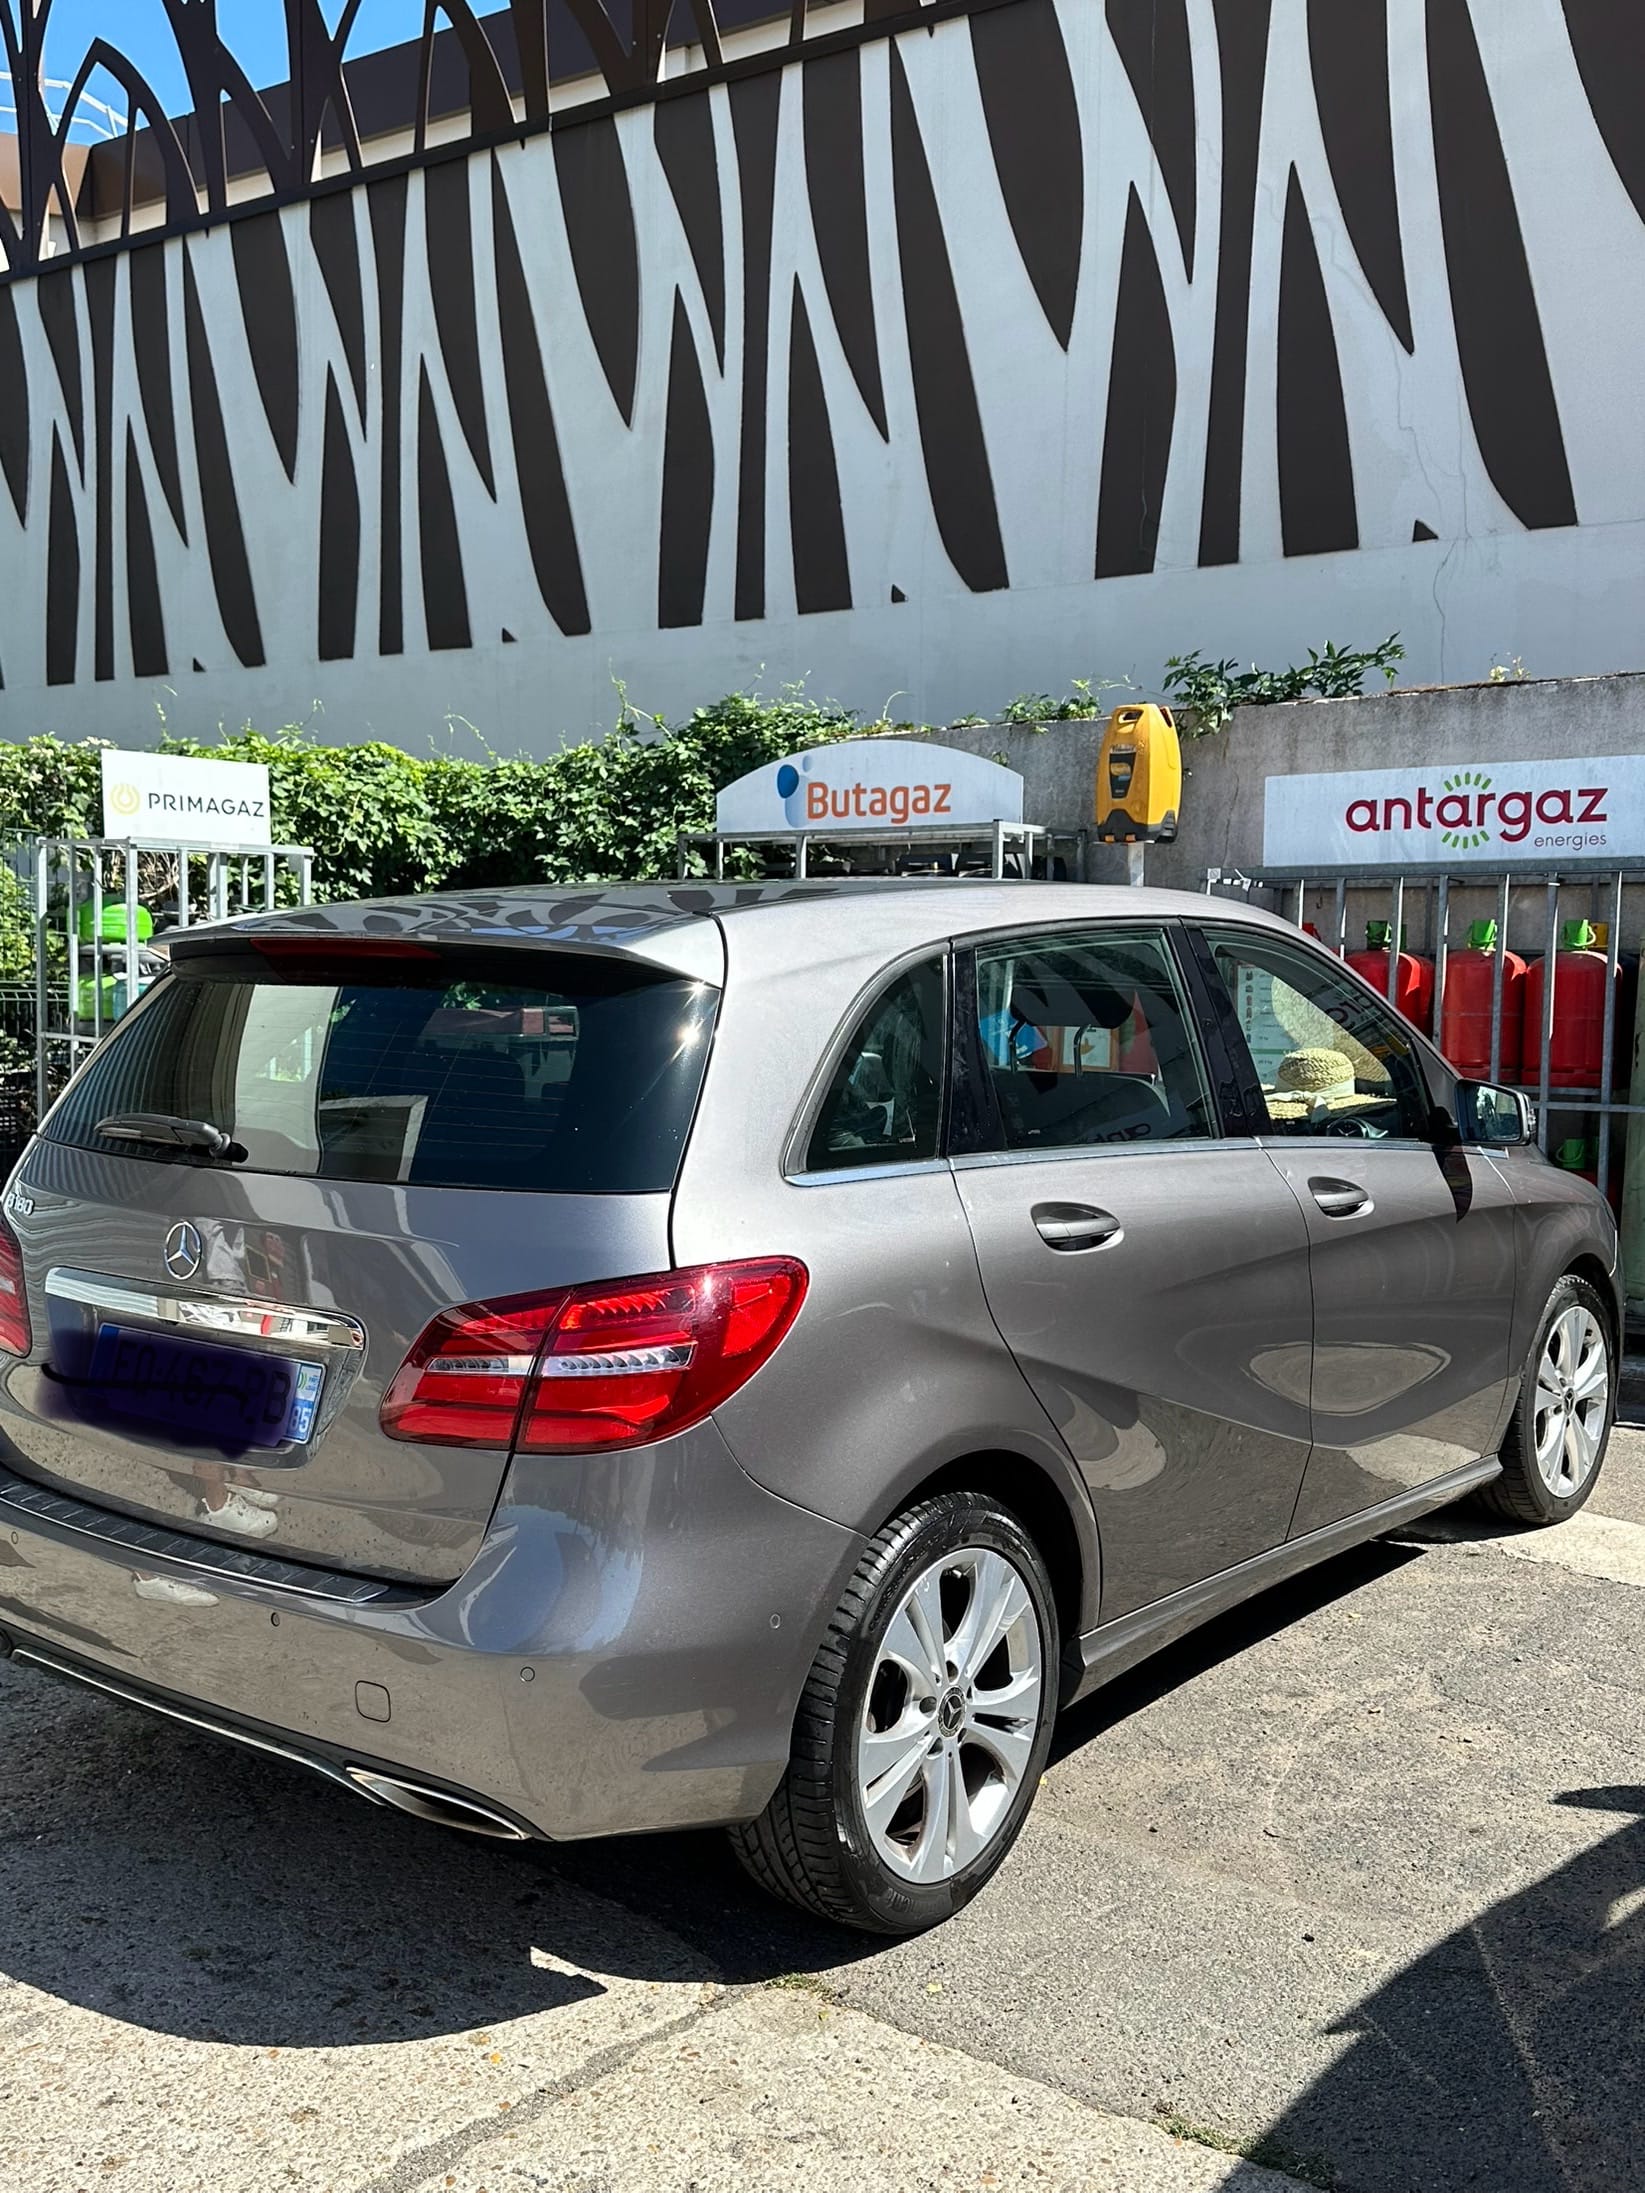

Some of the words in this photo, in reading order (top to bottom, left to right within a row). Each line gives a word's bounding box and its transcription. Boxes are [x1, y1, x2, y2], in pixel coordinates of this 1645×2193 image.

[148, 792, 265, 818] PRIMAGAZ
[807, 782, 951, 825] Butagaz
[1345, 787, 1609, 843] antargaz
[1533, 832, 1607, 850] energies
